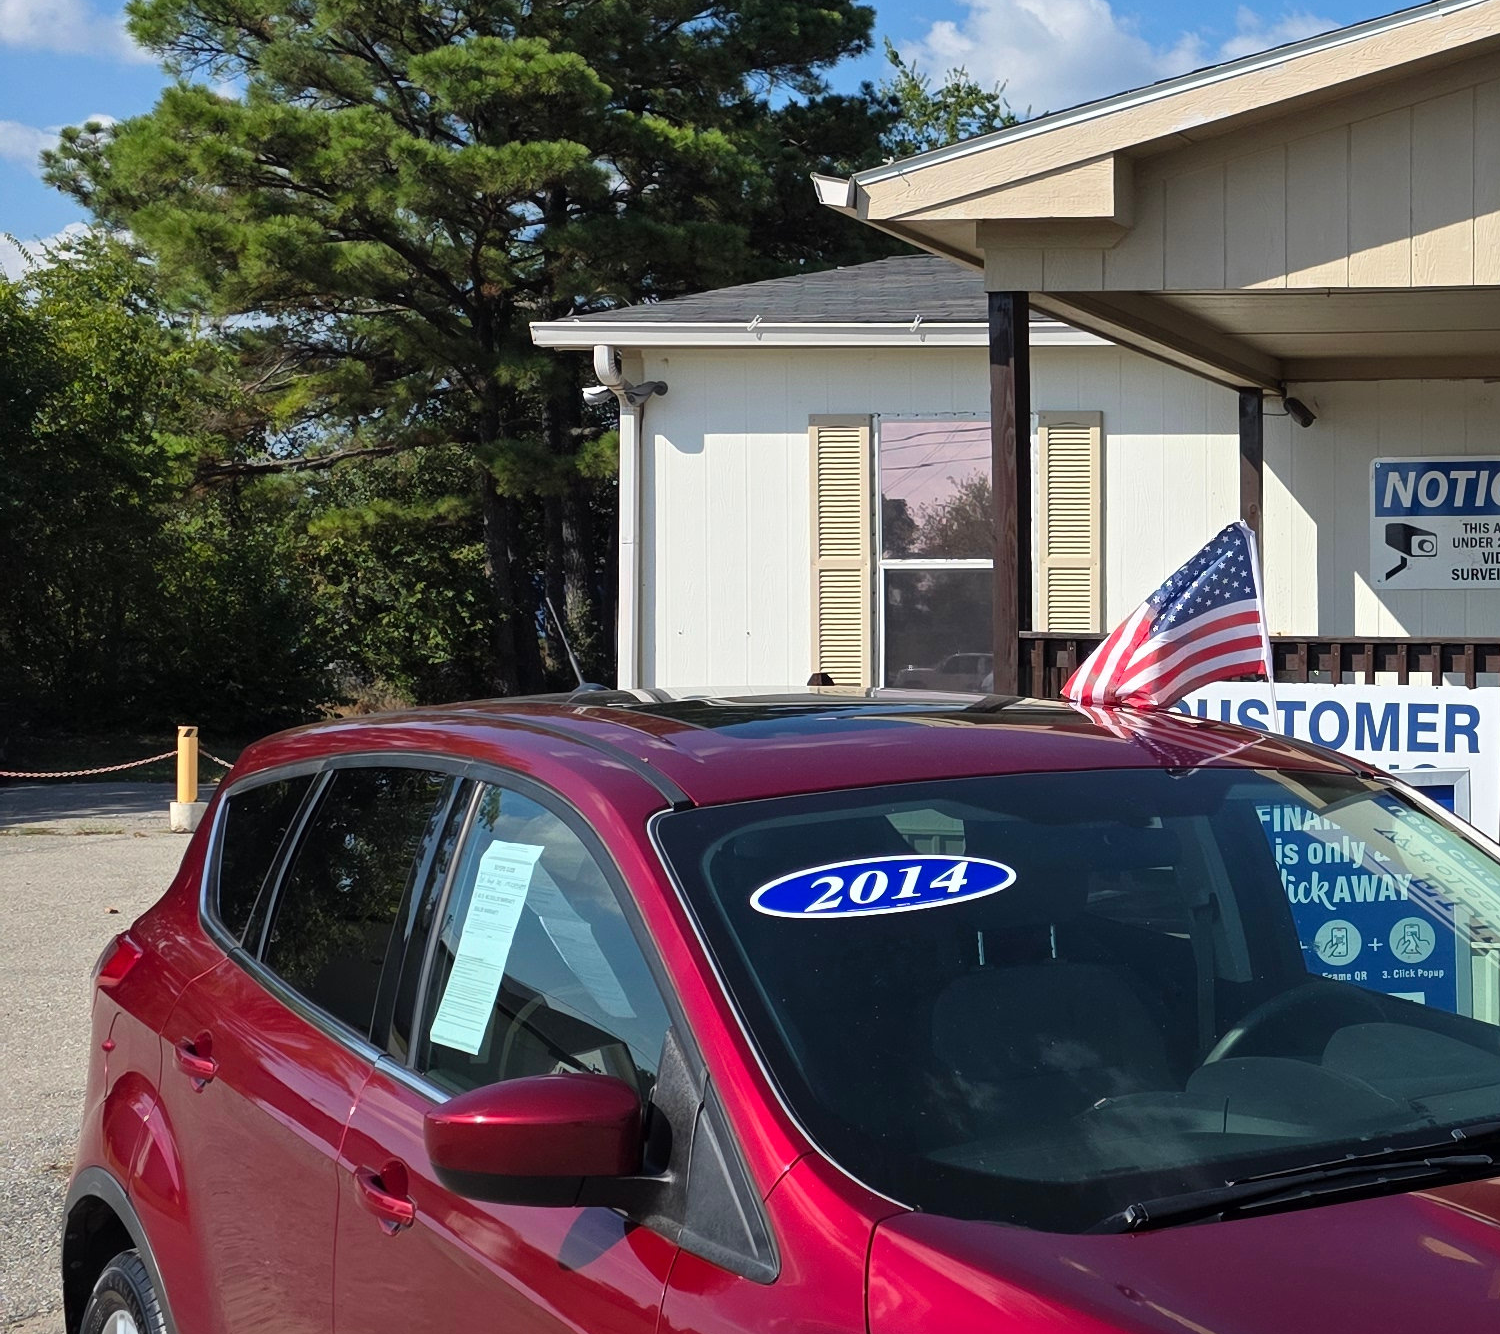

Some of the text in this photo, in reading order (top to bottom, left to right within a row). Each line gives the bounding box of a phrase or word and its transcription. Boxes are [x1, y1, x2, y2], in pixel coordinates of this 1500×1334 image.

[1462, 522, 1490, 534] THIS
[1452, 537, 1494, 549] UNDER
[1275, 837, 1299, 865] is
[1307, 835, 1366, 869] only
[804, 861, 969, 913] 2014
[1277, 867, 1413, 911] lickAWAY
[1354, 971, 1368, 981] QR
[1393, 969, 1416, 979] Click
[1417, 968, 1445, 979] Popup
